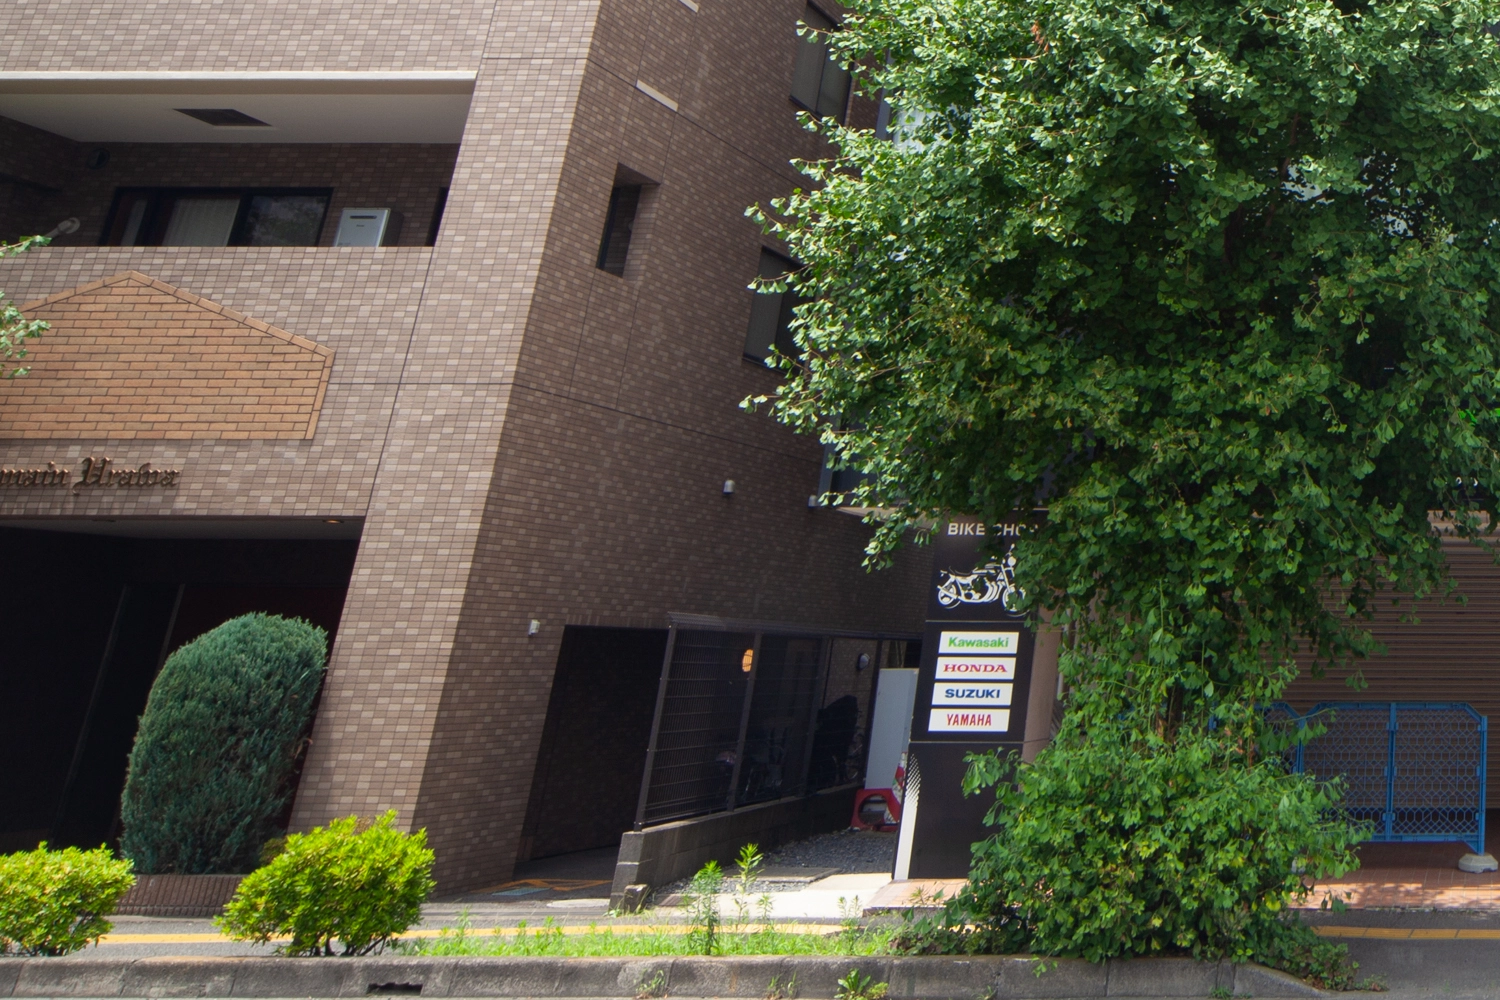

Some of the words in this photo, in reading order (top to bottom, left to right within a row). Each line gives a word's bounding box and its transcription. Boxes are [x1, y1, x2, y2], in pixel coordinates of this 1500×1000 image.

[947, 522, 986, 536] BIKE
[947, 636, 1010, 648] Kawasaki
[943, 663, 1008, 673] HONDA
[944, 688, 1001, 699] SUZUKI
[946, 713, 992, 726] YAMAHA
